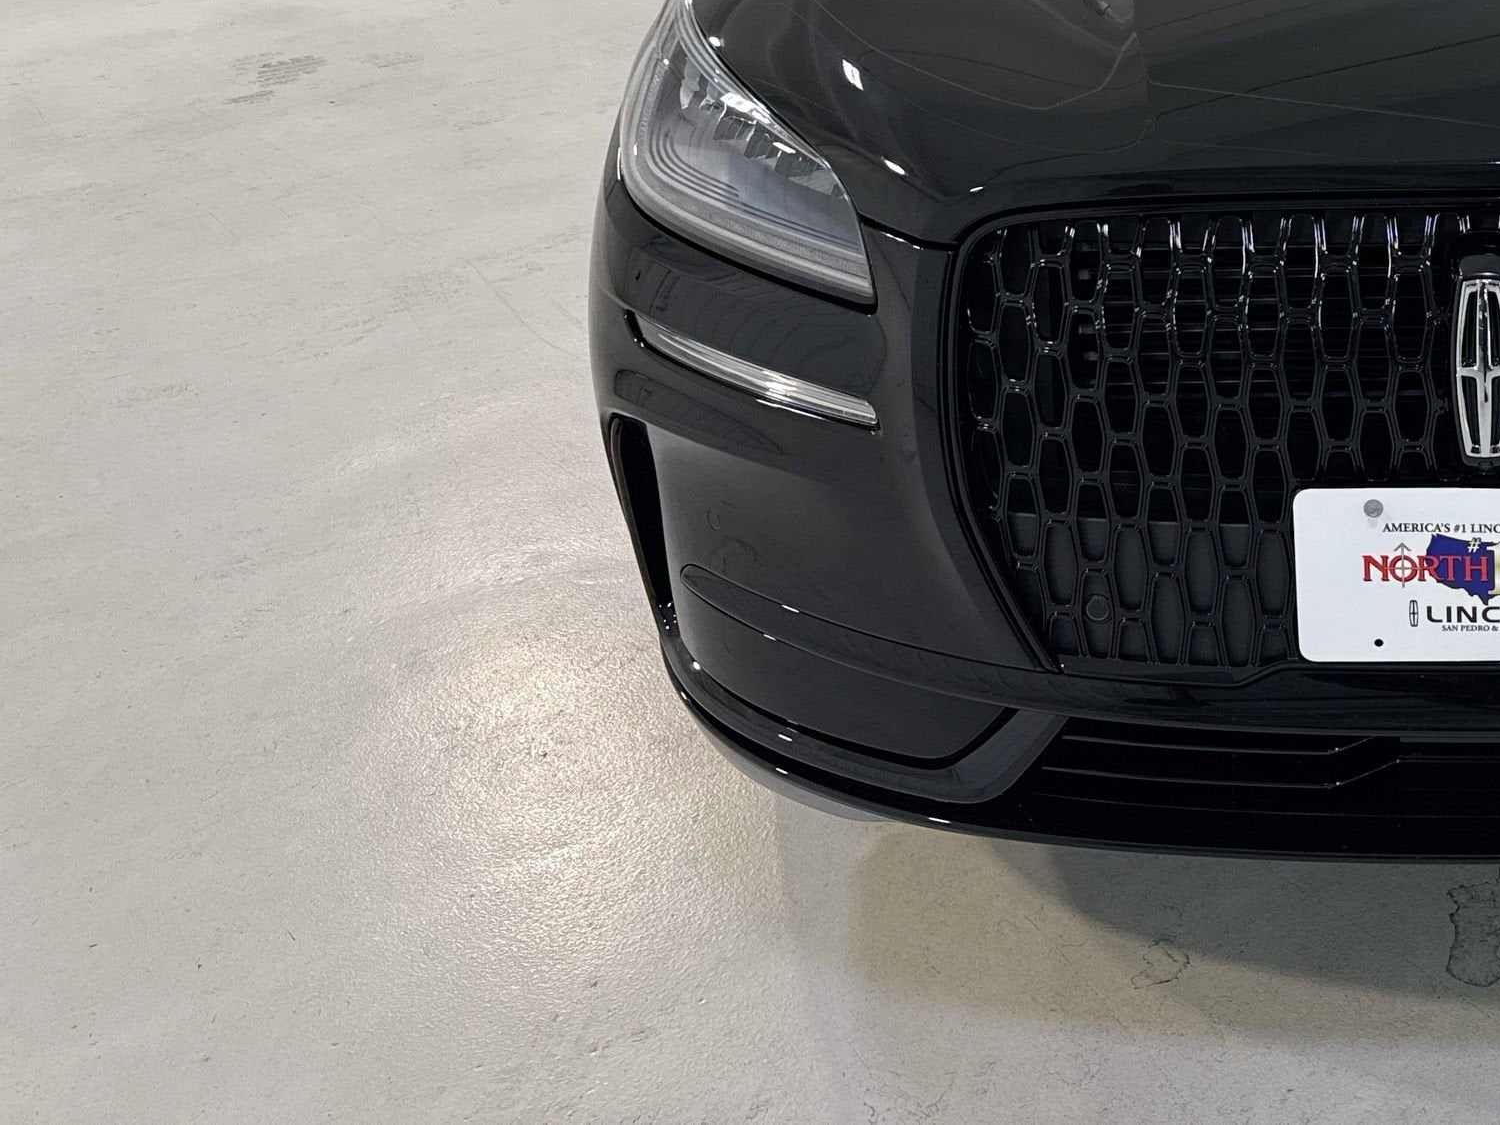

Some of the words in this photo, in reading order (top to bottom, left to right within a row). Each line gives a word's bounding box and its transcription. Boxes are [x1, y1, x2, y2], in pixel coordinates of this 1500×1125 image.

[1382, 522, 1451, 534] AMERICA'S
[1453, 523, 1468, 534] #1
[1361, 554, 1490, 583] NORTH
[1441, 624, 1458, 632] SAN
[1460, 624, 1490, 632] PEDRO
[1491, 624, 1499, 632] &
